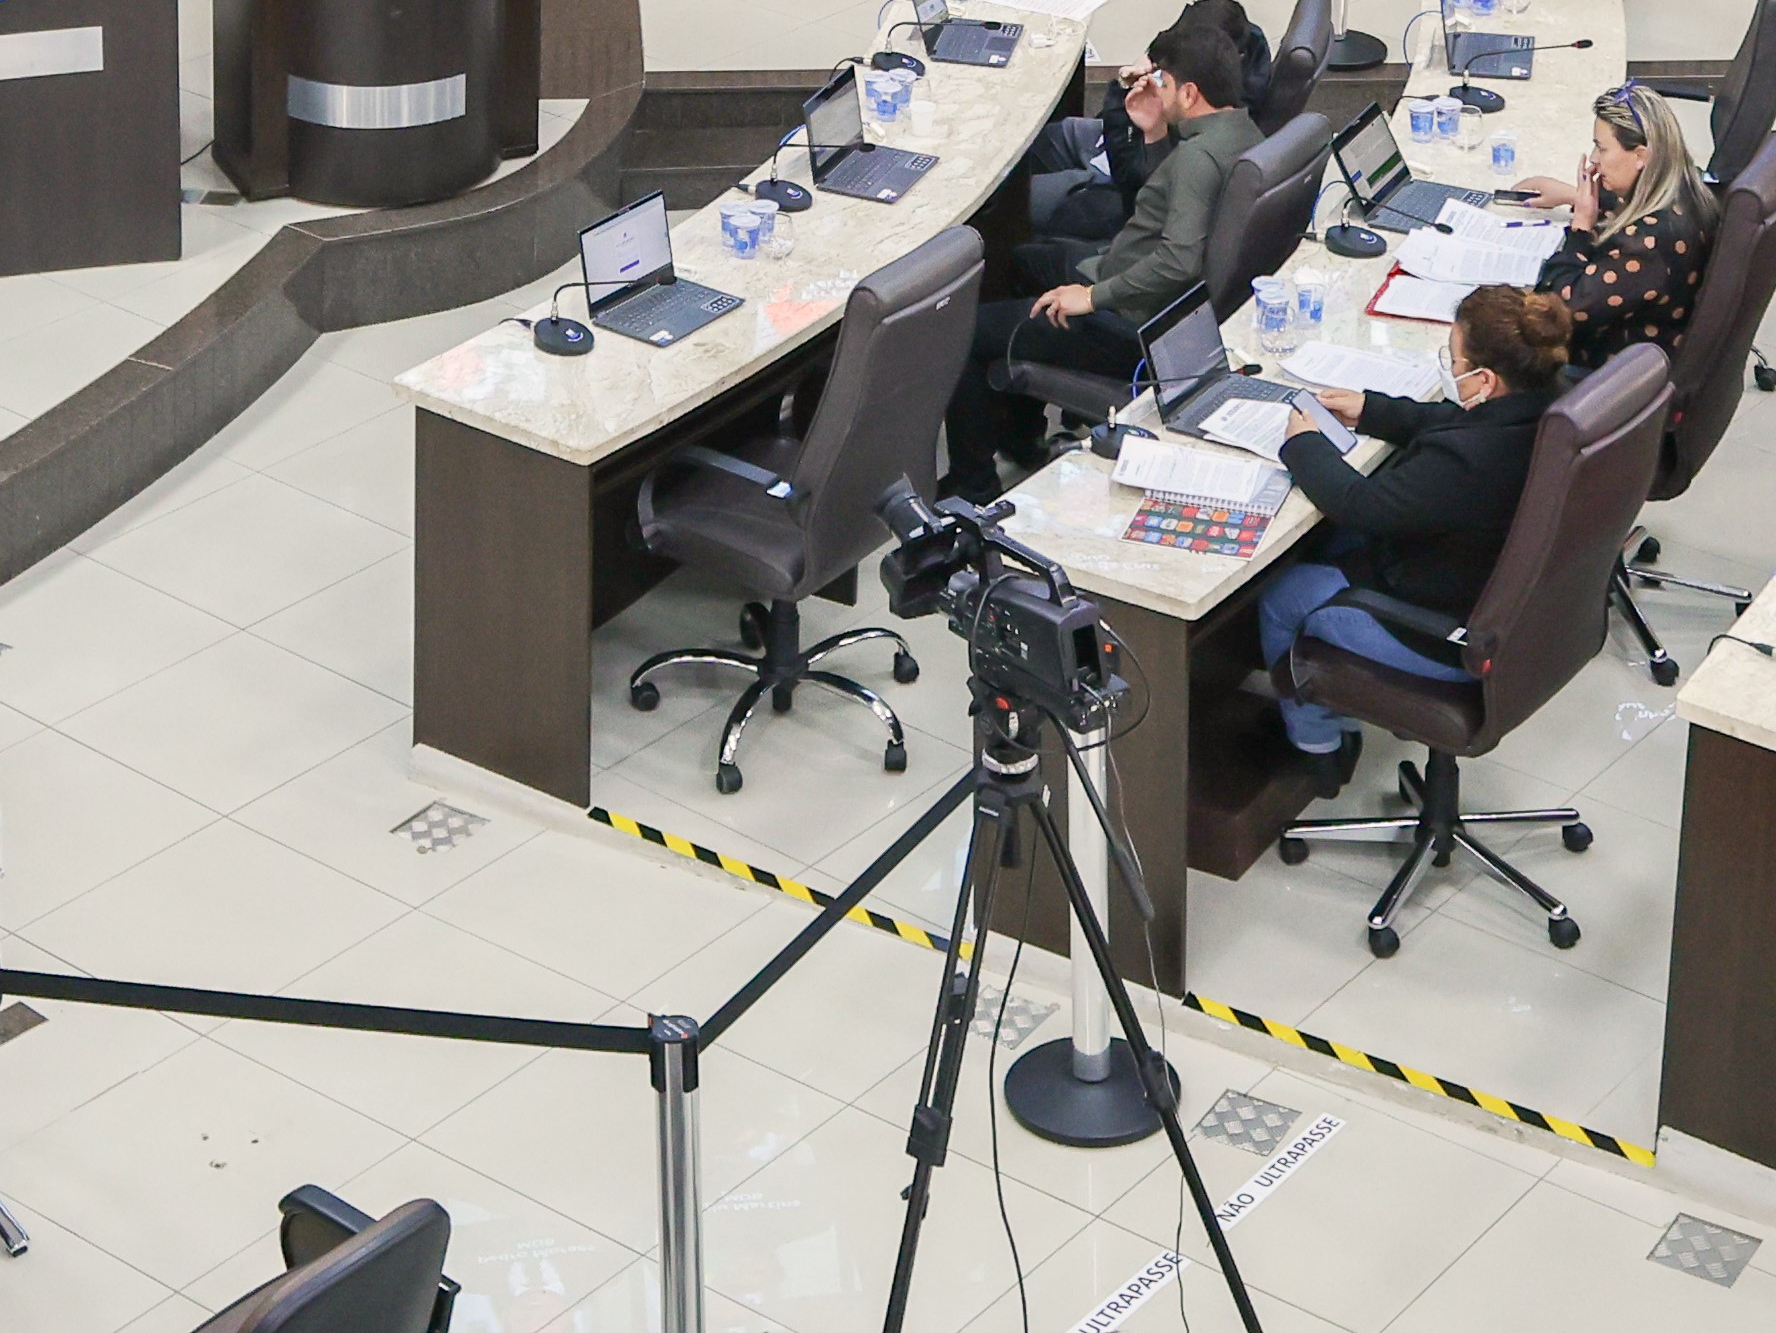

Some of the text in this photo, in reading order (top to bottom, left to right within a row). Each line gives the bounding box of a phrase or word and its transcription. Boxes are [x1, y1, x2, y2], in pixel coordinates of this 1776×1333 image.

[1216, 1116, 1340, 1223] NÃO ULTRAPASSE
[1078, 1252, 1183, 1333] ULTRAPASSE
